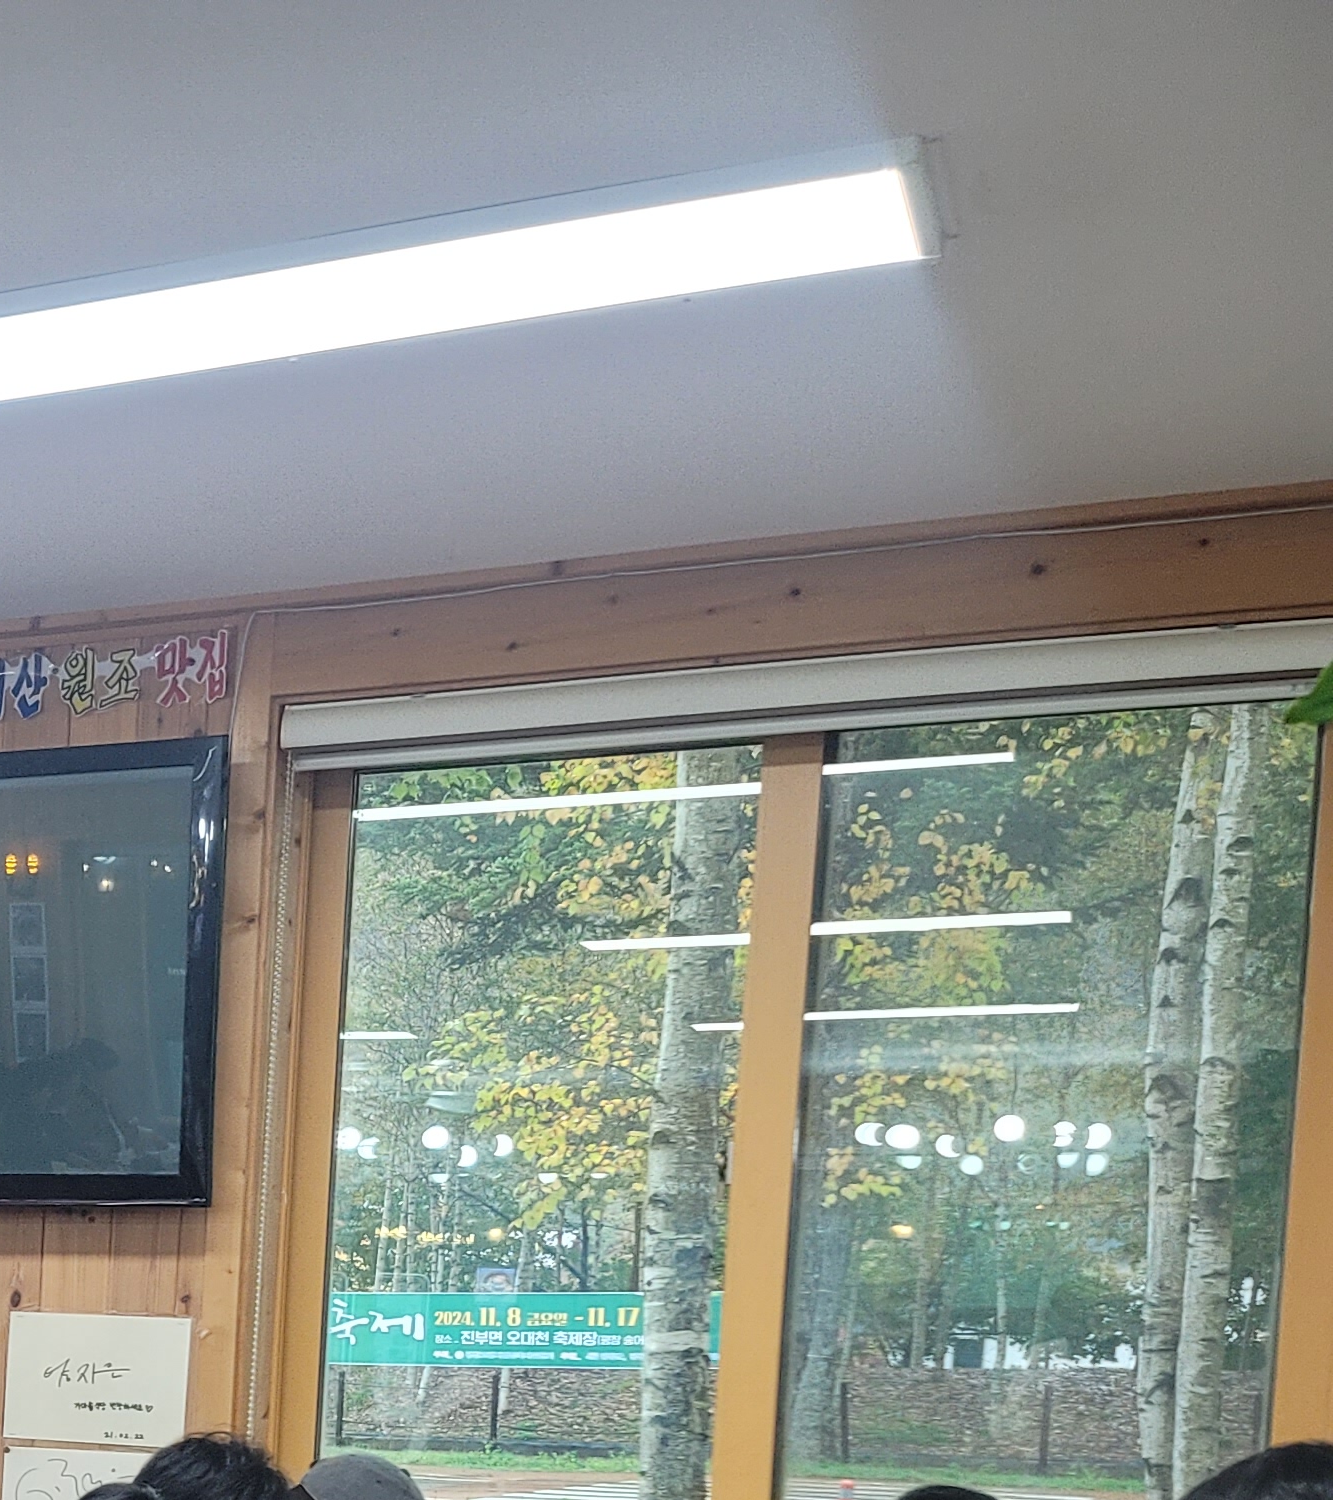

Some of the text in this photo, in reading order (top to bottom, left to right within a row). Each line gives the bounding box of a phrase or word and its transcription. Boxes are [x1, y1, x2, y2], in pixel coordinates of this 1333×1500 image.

[60, 645, 141, 716] 원조
[153, 629, 229, 708] 맛집
[329, 1298, 425, 1346] 축제
[434, 1311, 475, 1326] 2024.
[479, 1307, 501, 1327] 11.
[507, 1307, 522, 1327] 8
[587, 1307, 611, 1327] 11.
[617, 1307, 641, 1327] 17
[460, 1331, 503, 1346] 진부면
[507, 1331, 550, 1346] 오대천
